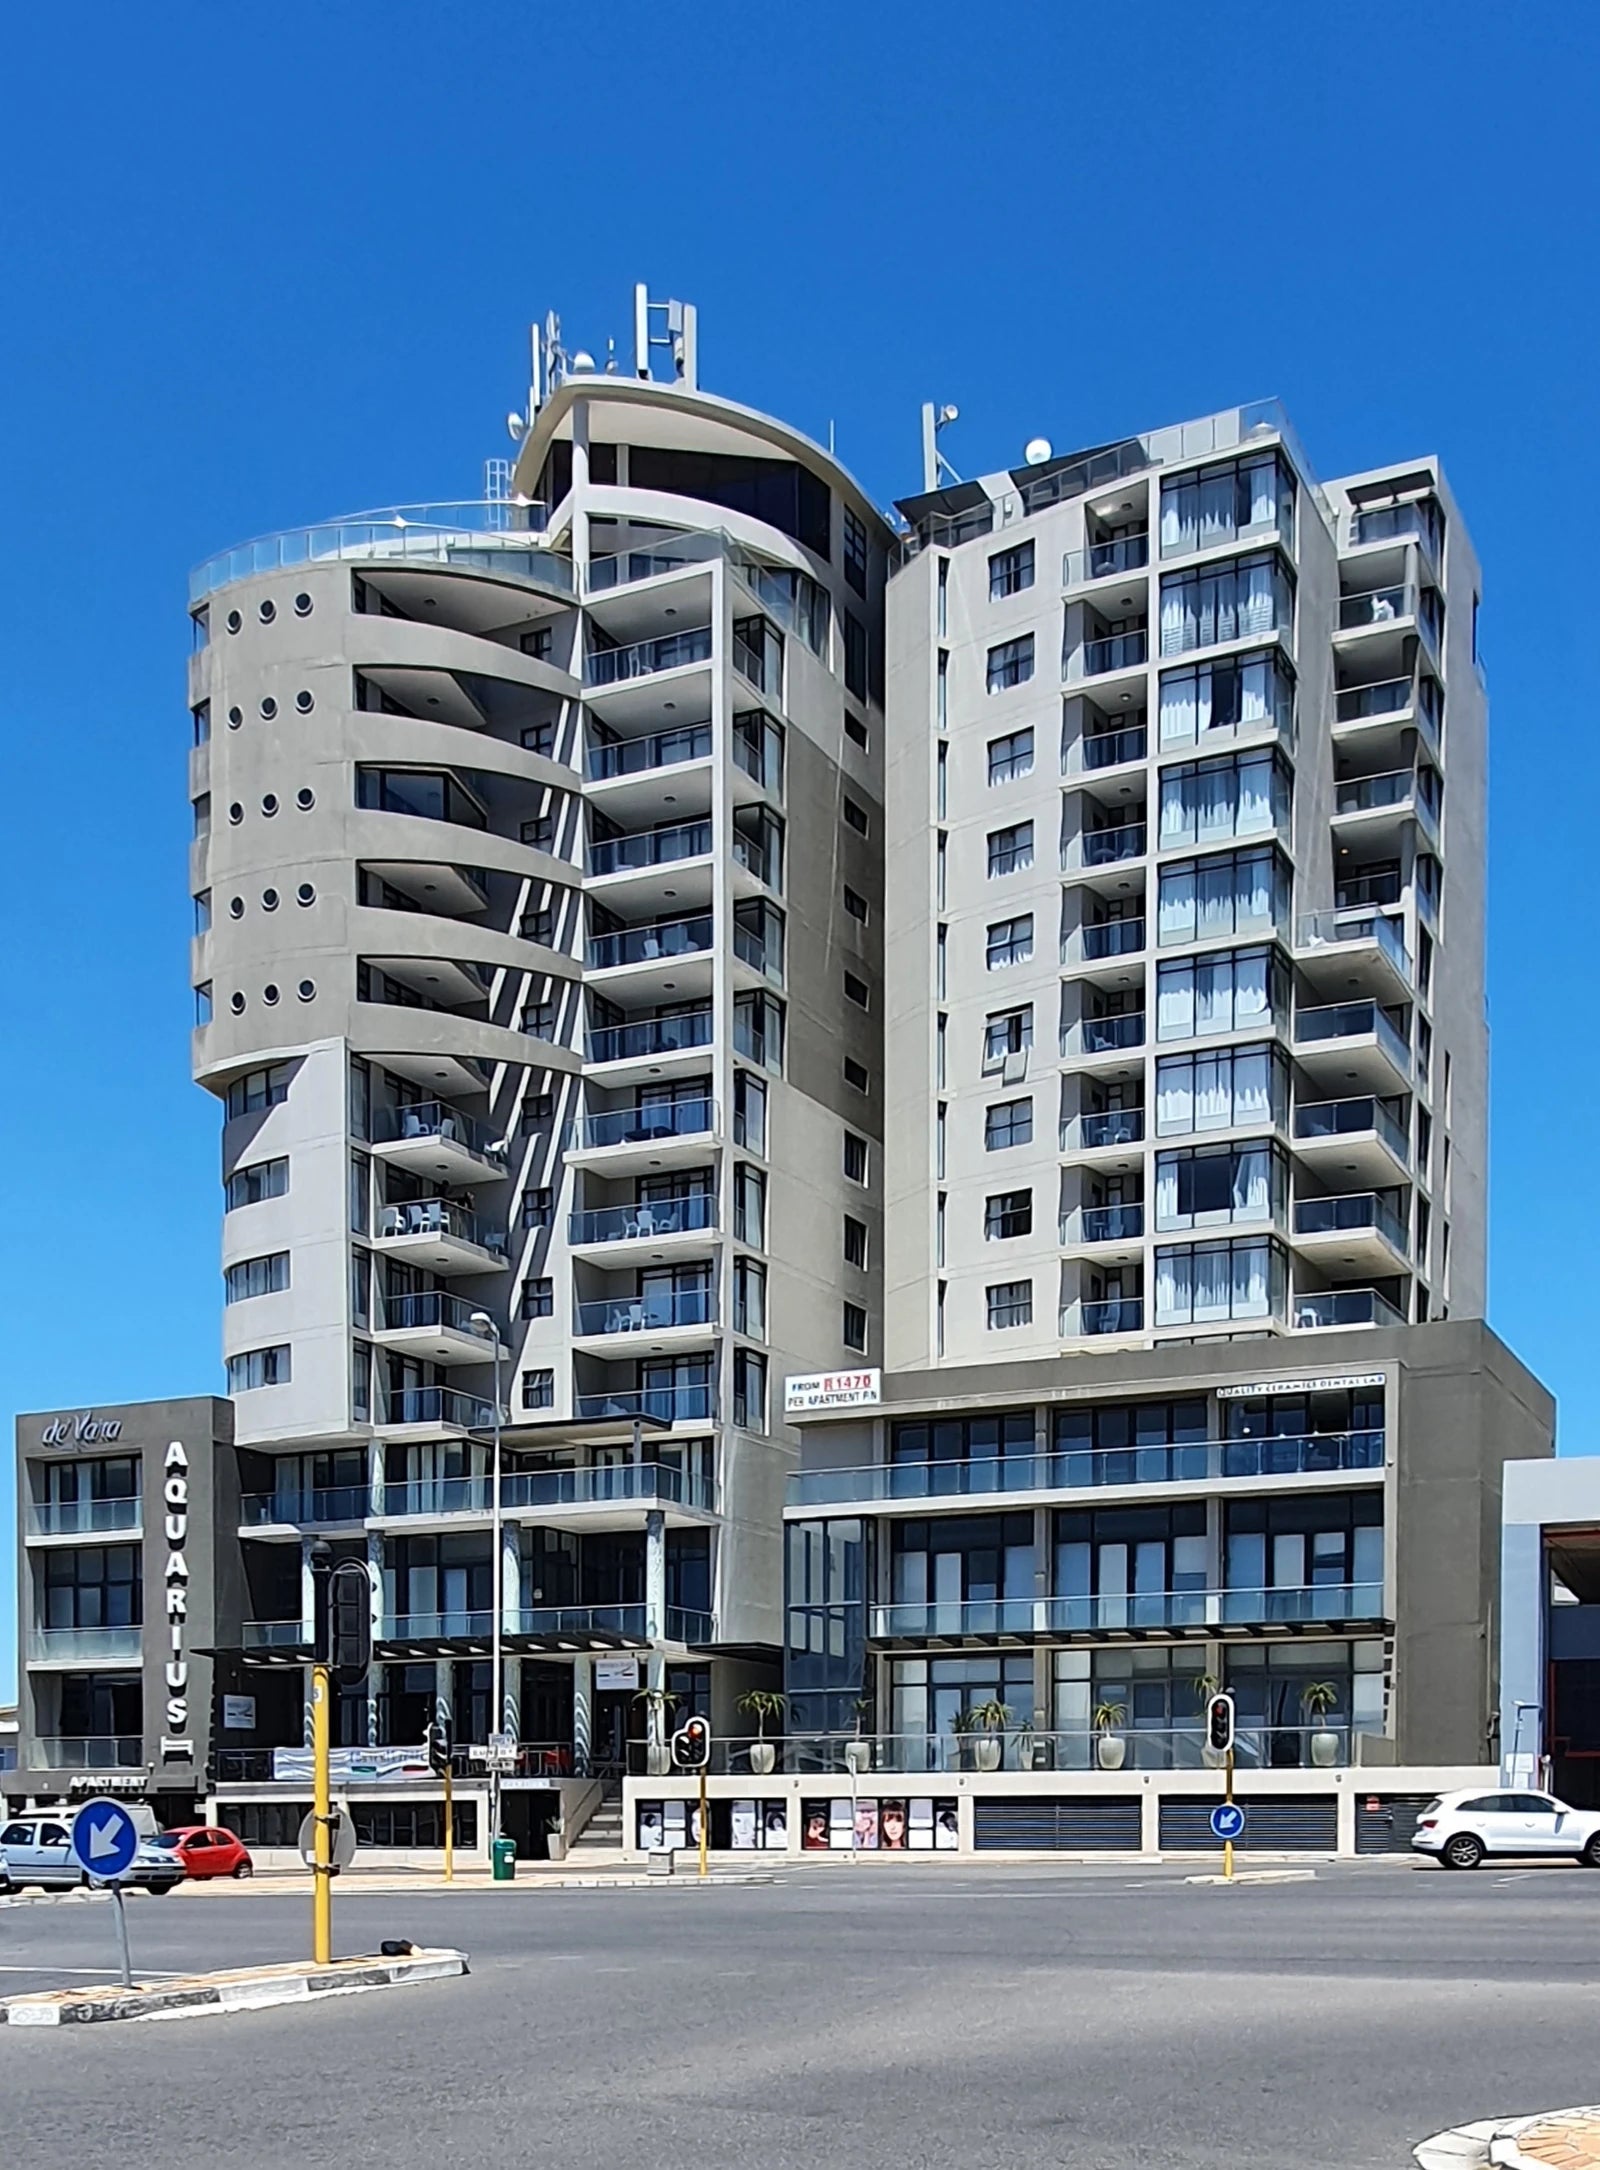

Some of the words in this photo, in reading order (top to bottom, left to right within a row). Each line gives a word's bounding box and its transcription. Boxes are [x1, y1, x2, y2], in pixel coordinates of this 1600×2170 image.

[792, 1382, 820, 1391] FROM
[1218, 1386, 1264, 1397] QUALITY
[1265, 1381, 1317, 1392] CERAMICS
[1320, 1378, 1359, 1388] DENTAL
[788, 1396, 804, 1406] PER
[808, 1391, 860, 1405] APARTMENT
[164, 1441, 189, 1724] AQUARIUS
